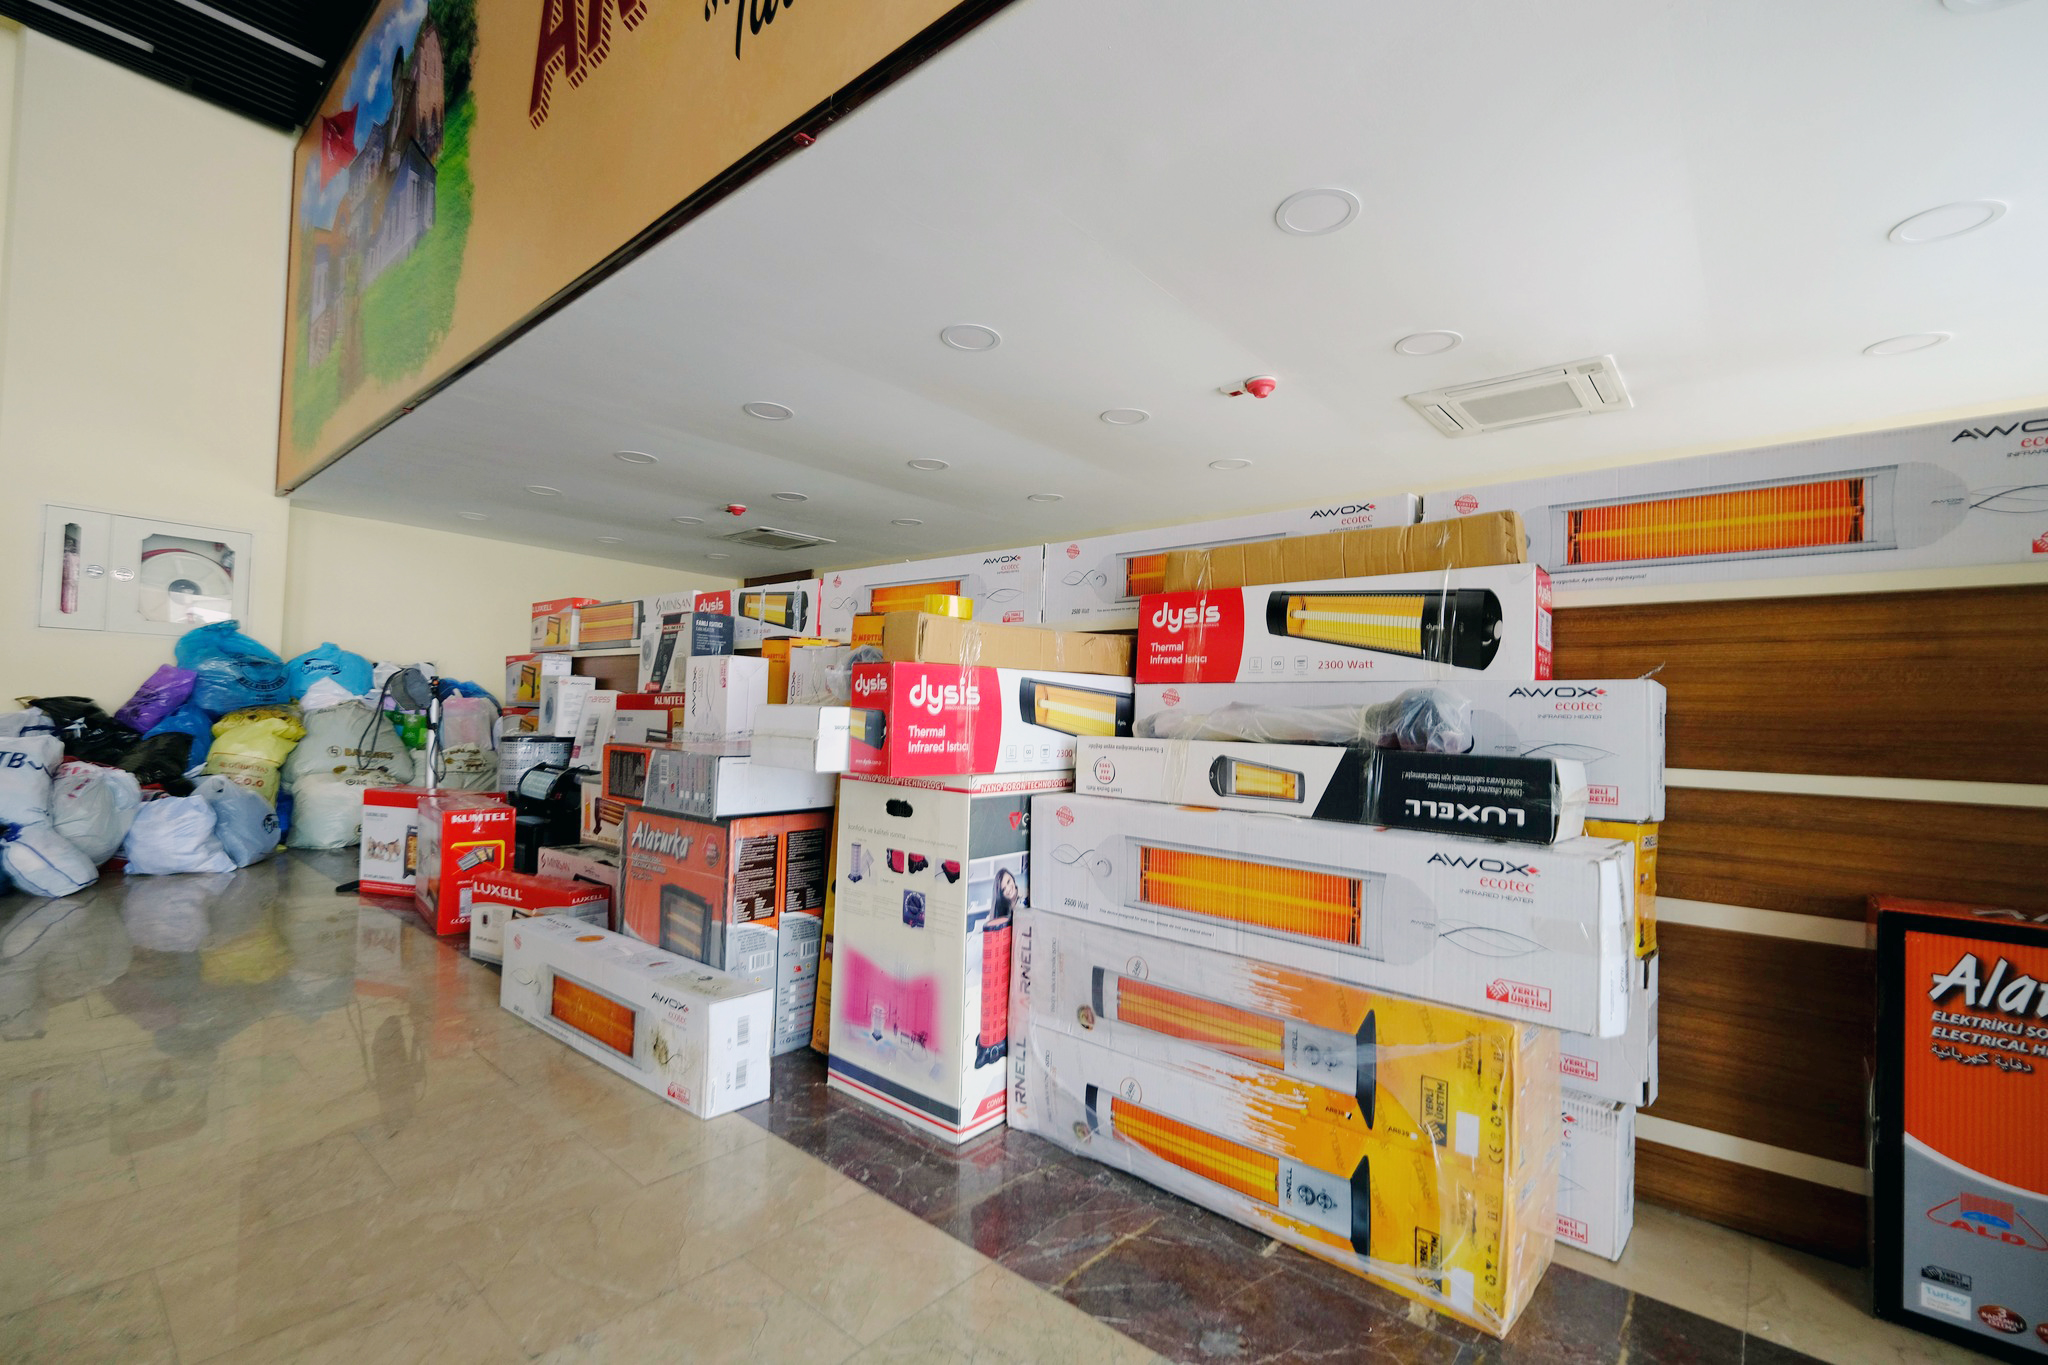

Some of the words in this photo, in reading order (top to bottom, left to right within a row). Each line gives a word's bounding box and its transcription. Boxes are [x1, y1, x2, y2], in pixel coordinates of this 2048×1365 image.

[1952, 418, 2048, 442] AWO
[2021, 436, 2048, 448] ec
[1310, 503, 1370, 519] AWOX
[1341, 514, 1373, 525] ecotec
[983, 554, 1018, 565] AWOX
[699, 597, 724, 614] dysis
[1152, 600, 1220, 633] dysis
[1150, 641, 1184, 652] Thermal
[1150, 653, 1182, 664] Infrared
[1317, 660, 1343, 670] 2300
[1347, 660, 1374, 669] Watt
[855, 672, 887, 697] dysis
[1509, 687, 1598, 697] AWOX
[909, 674, 980, 715] dysis
[1555, 701, 1602, 711] ecotec
[908, 725, 946, 739] Thermal
[908, 740, 945, 753] Infrared
[1056, 749, 1073, 758] 2300
[858, 774, 875, 782] NANO
[876, 775, 900, 785] BORON
[900, 778, 945, 790] TECHNOLOGY
[981, 783, 1001, 794] NANO
[1002, 781, 1027, 792] BORON
[1027, 778, 1068, 790] TECHNOLOGY
[1588, 795, 1615, 804] RETİM
[451, 812, 509, 825] KUMTEL
[1405, 799, 1525, 827] LUXELL
[631, 820, 690, 861] Alaturka
[1427, 852, 1530, 877] AWOX
[472, 881, 522, 902] LUXELL
[1480, 875, 1535, 894] ecotec
[571, 893, 604, 904] LUXELL
[1064, 897, 1077, 908] 2500
[1459, 888, 1499, 899] INFRARED
[1503, 894, 1534, 904] HEATER
[1511, 985, 1540, 997] YERLİ
[1511, 992, 1549, 1009] ÜRETİM
[1931, 1010, 2024, 1035] ELEKTRİKLİ
[1931, 1026, 2029, 1053] ELECTRICAL
[2033, 1044, 2048, 1056] H
[1563, 1064, 1595, 1078] ÜRETİM
[1564, 1057, 1588, 1069] YERLİ
[1424, 1088, 1434, 1117] YERLİ
[1434, 1082, 1445, 1120] ÜRETİM
